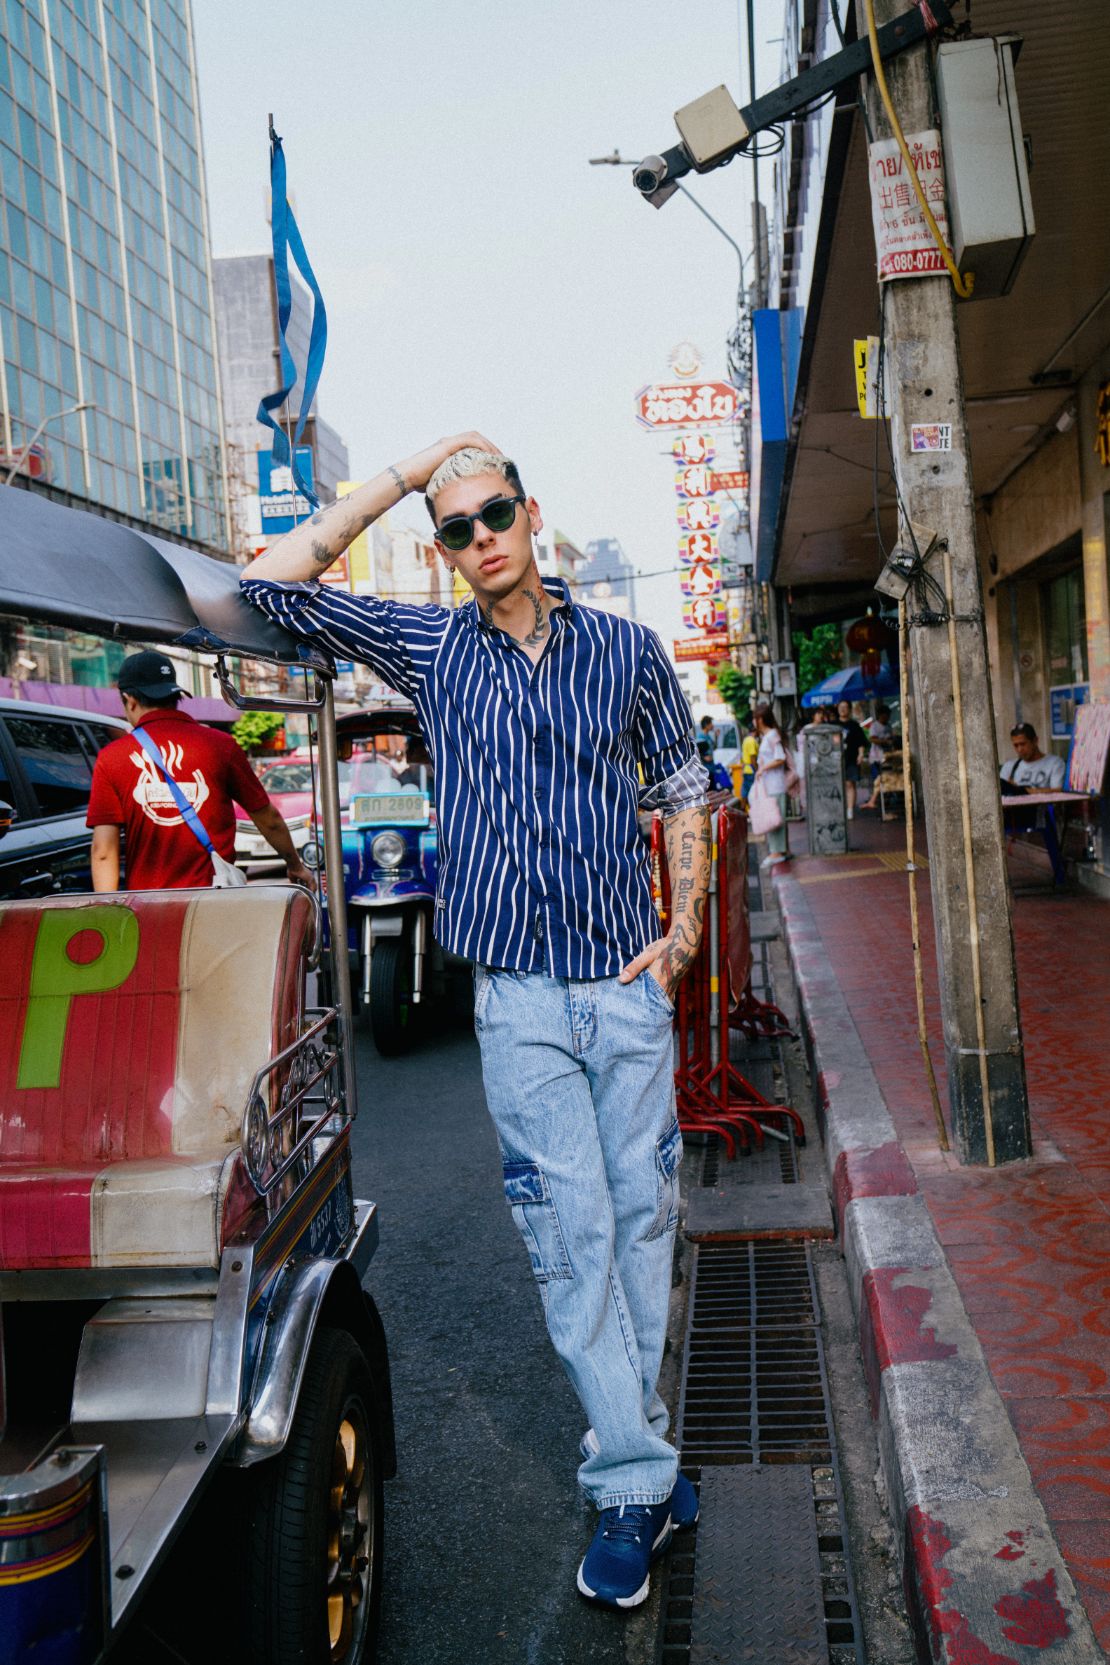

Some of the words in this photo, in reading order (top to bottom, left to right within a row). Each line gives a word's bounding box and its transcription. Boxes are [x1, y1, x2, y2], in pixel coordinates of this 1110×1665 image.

[893, 250, 947, 271] 080-0777
[939, 426, 950, 437] NT
[810, 695, 833, 705] PEPSI
[680, 831, 697, 871] Carpe
[676, 877, 695, 914] Diem
[17, 906, 140, 1089] P
